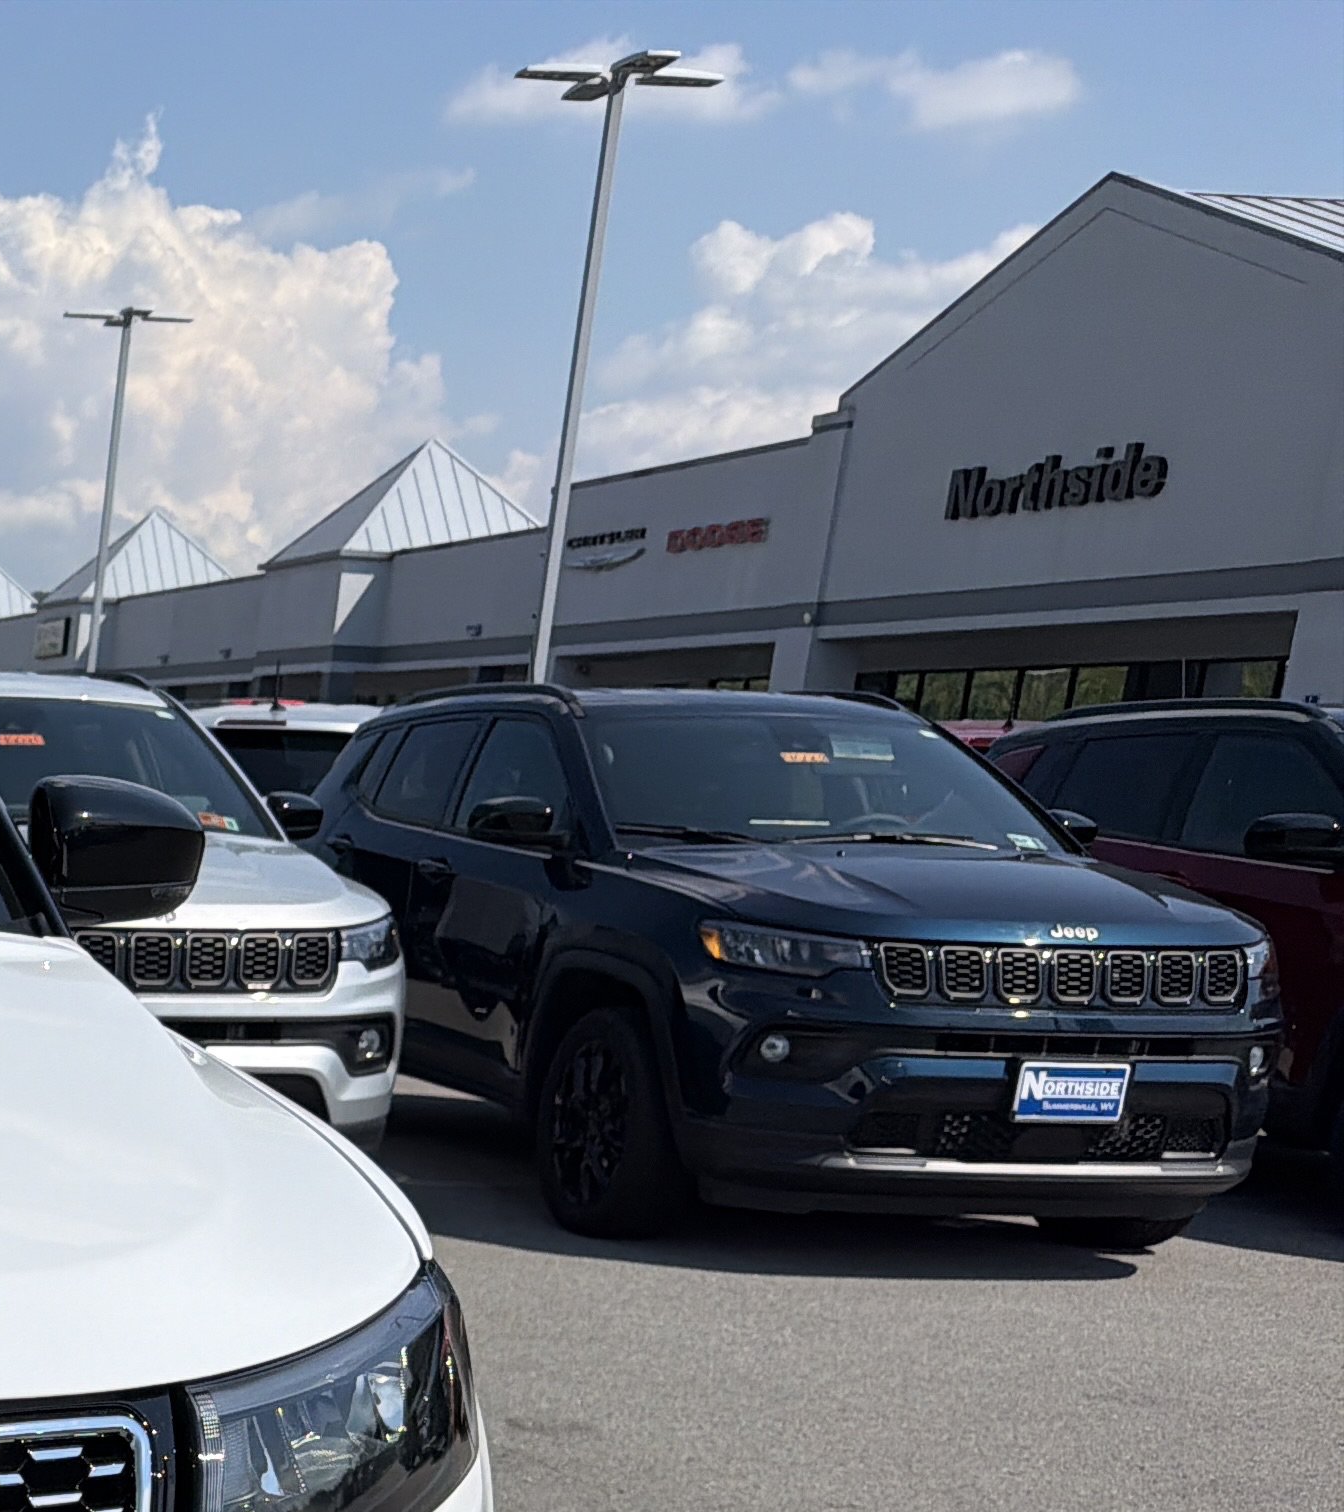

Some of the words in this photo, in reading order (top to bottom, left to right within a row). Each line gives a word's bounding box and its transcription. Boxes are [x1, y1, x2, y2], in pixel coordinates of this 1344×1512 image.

[944, 442, 1169, 520] Northside
[1050, 923, 1099, 941] Jeep
[1020, 1070, 1121, 1101] NORTHSIDE
